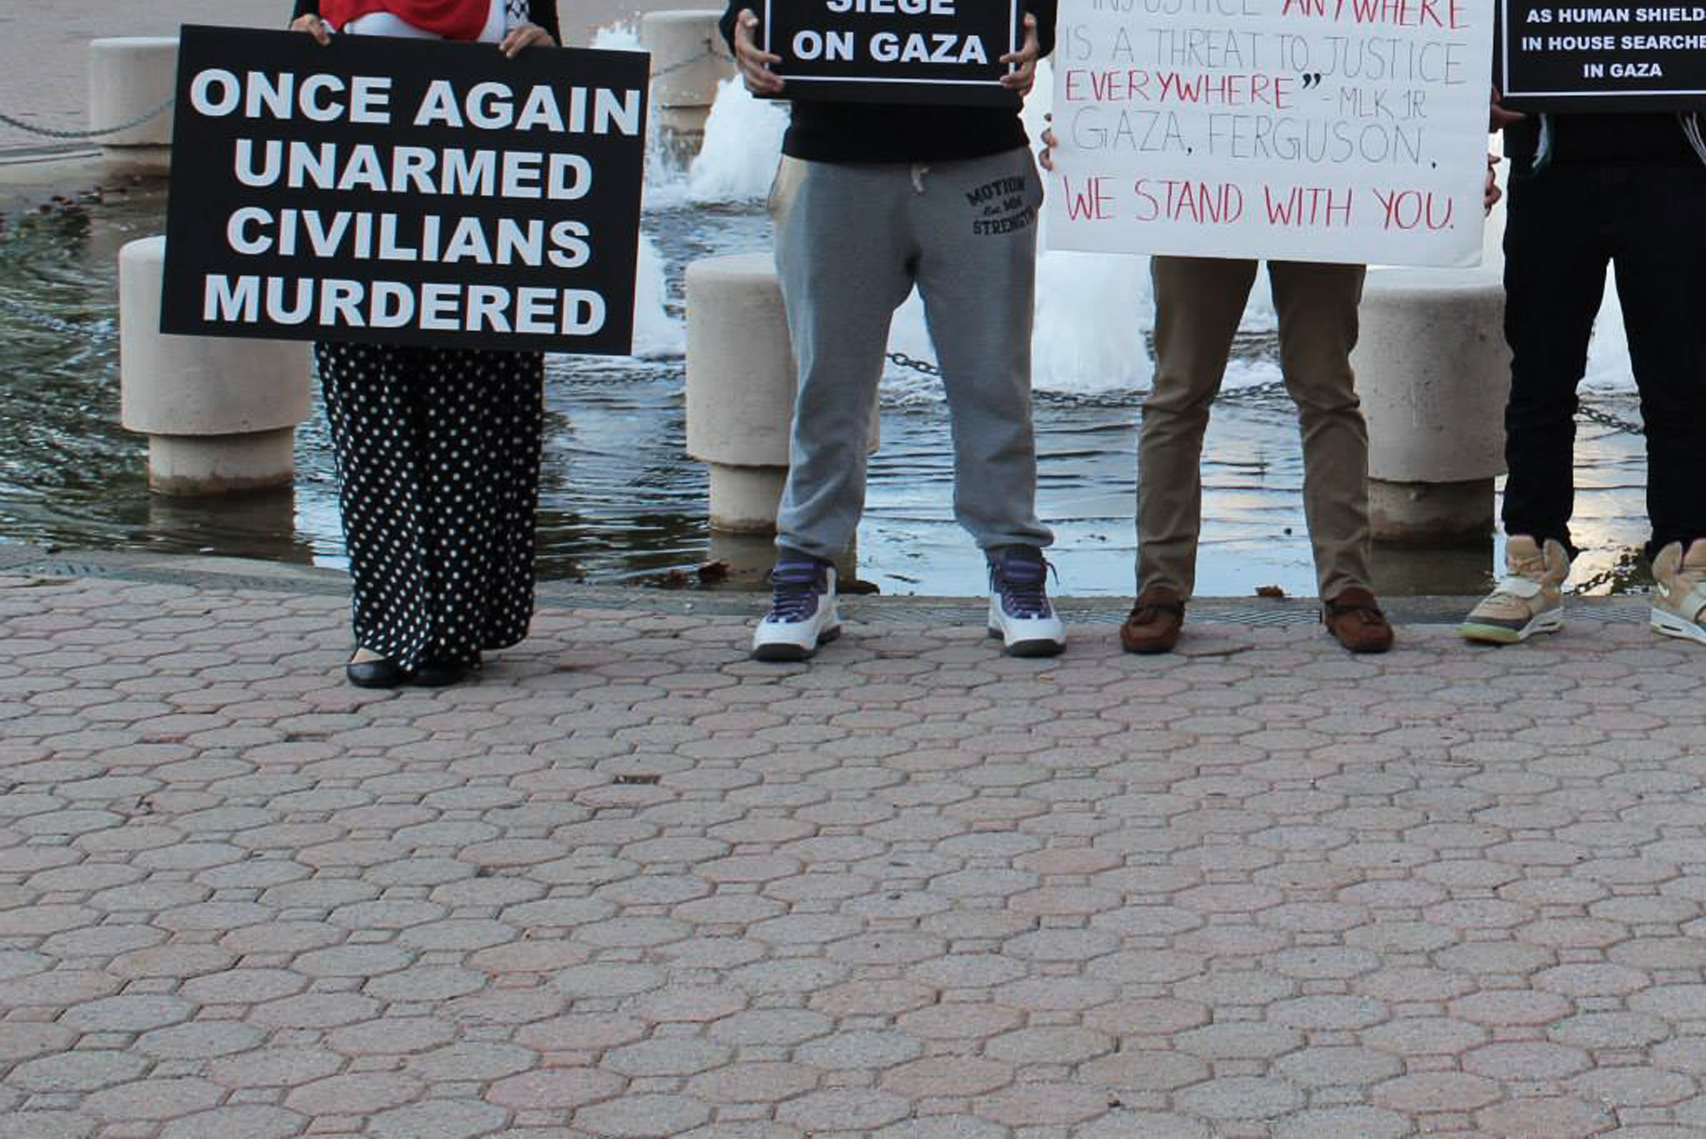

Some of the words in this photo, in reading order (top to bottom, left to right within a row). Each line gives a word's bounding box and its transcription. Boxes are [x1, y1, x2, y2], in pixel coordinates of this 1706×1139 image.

[1522, 37, 1541, 50] IN
[1550, 36, 1615, 50] HOUSE
[1526, 9, 1551, 23] AS
[1558, 8, 1629, 22] HUMAN
[793, 30, 854, 60] ON
[870, 32, 987, 64] GAZA
[1066, 24, 1093, 61] IS
[1112, 25, 1135, 62] A
[1148, 28, 1264, 68] THREAT
[1280, 34, 1309, 73] TO
[1320, 36, 1468, 85] JUSTICE
[1584, 64, 1603, 78] IN
[1610, 63, 1662, 78] GAZA
[190, 68, 393, 124] ONCE
[413, 79, 641, 137] AGAIN
[1071, 106, 1193, 155] GAZA,
[234, 138, 592, 201] UNARMED
[1064, 175, 1115, 223] WE
[1134, 179, 1243, 224] STAND
[1264, 184, 1353, 228] WITH
[1373, 189, 1455, 230] YOU.
[226, 206, 591, 269] CIVILIANS
[203, 274, 607, 337] MURDERED
